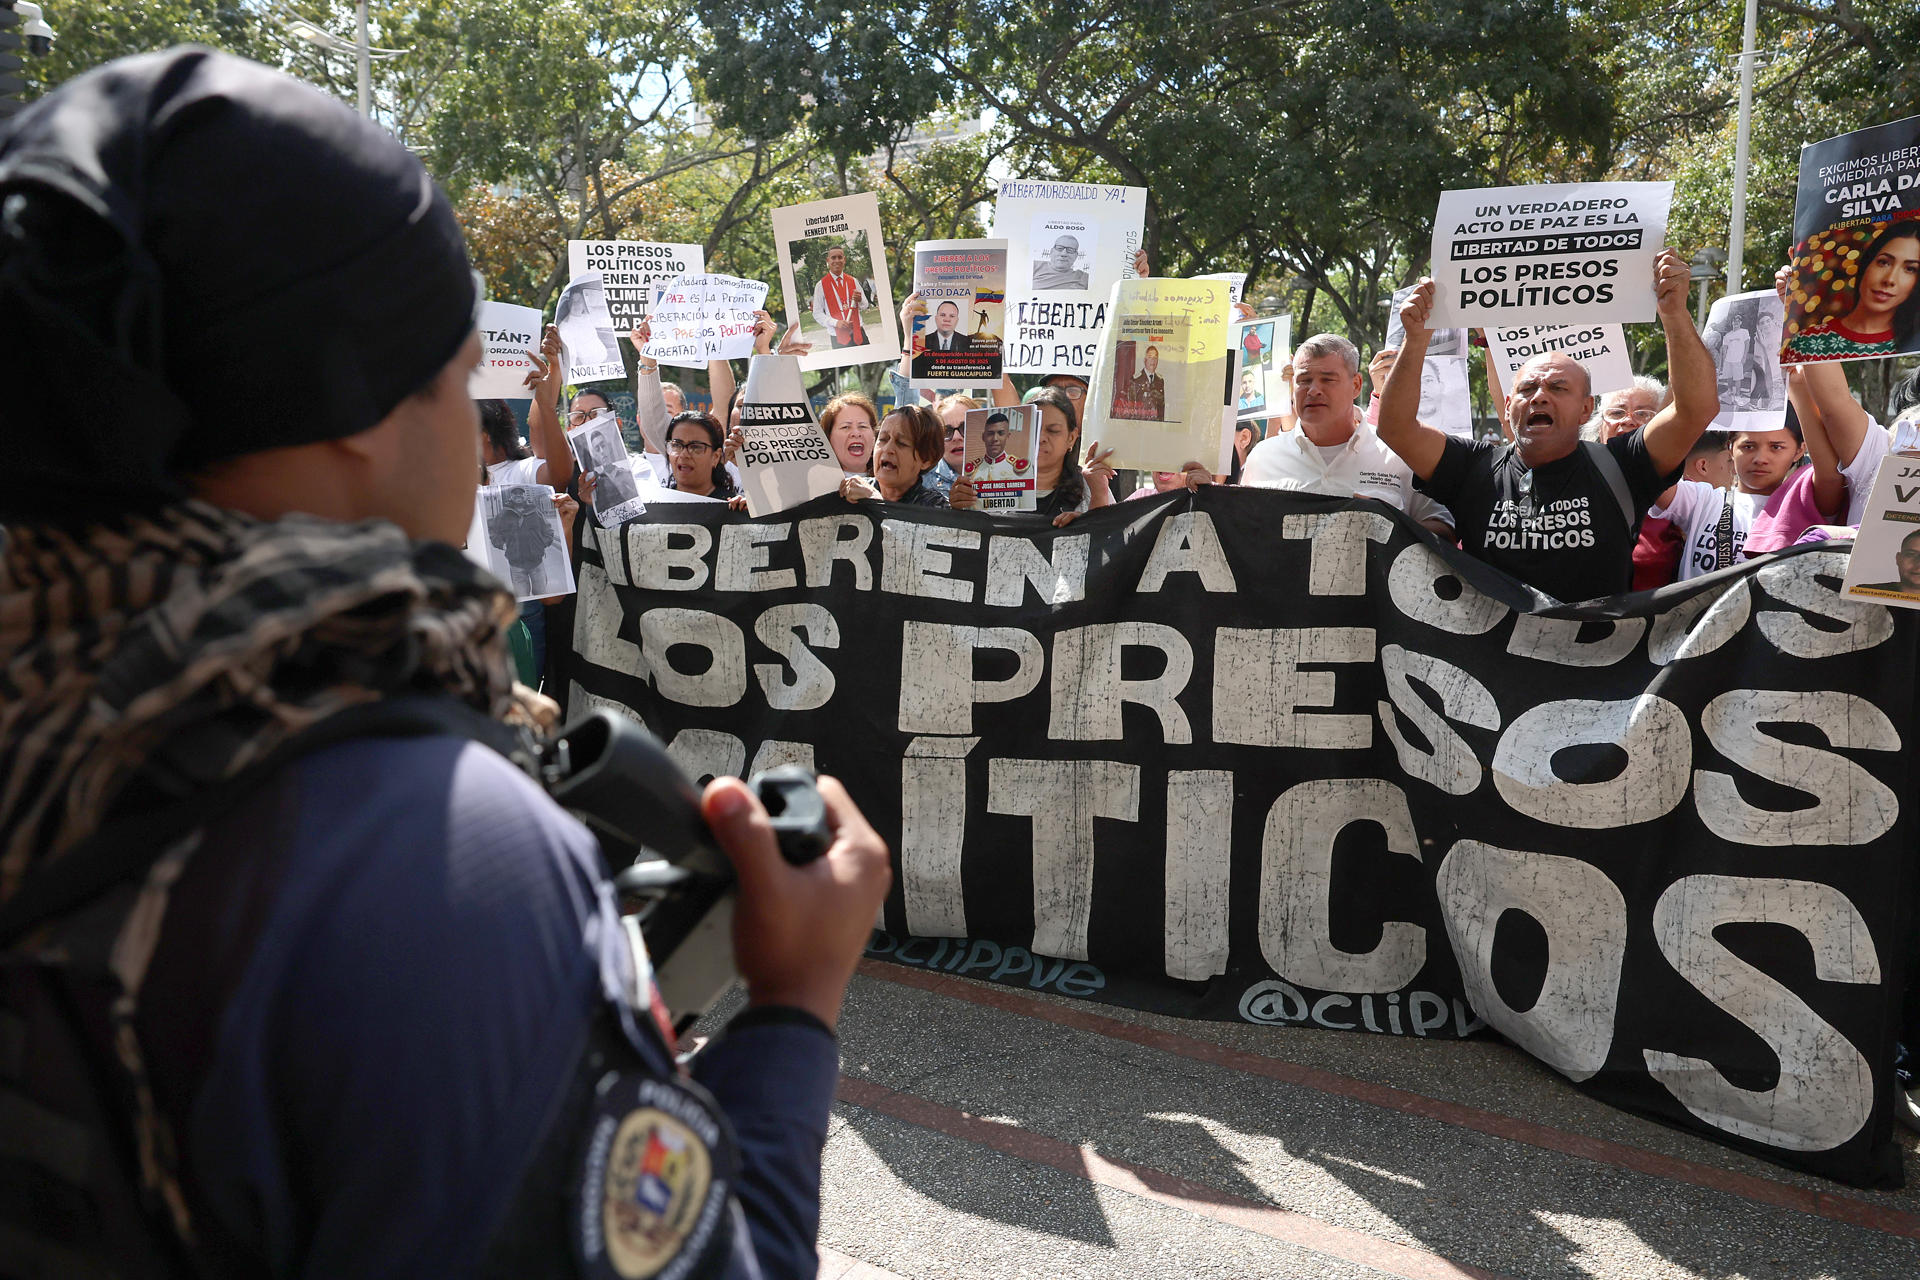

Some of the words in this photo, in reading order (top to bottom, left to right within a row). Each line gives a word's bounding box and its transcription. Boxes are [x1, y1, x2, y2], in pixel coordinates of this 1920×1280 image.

[1819, 155, 1878, 178] EXIGIMOS
[1823, 163, 1894, 187] INMEDIATA
[1105, 187, 1126, 203] YA!
[1825, 178, 1892, 204] CARLA
[1475, 205, 1502, 218] UN
[1507, 198, 1629, 216] VERDADERO
[1842, 194, 1902, 218] SILVA
[804, 227, 828, 238] KENNEDY
[828, 223, 849, 234] TEJEDA
[805, 214, 830, 226] Libertad
[830, 213, 844, 223] para
[1454, 220, 1504, 235] ACTO
[1509, 218, 1535, 231] DE
[1541, 216, 1579, 229] PAZ
[1584, 214, 1608, 226] ES
[1613, 212, 1639, 225] LA
[586, 245, 614, 256] LOS
[618, 245, 673, 258] PRESOS
[1453, 239, 1539, 257] LIBERTAD
[1543, 238, 1569, 251] DE
[1573, 233, 1640, 249] TODOS
[587, 257, 663, 271] POLÍTICOS
[666, 260, 686, 272] NO
[1460, 265, 1507, 285] LOS
[1515, 259, 1619, 282] PRESOS
[602, 273, 639, 285] ENEN
[919, 289, 943, 297] USTO
[946, 288, 971, 297] DAZA
[1460, 282, 1614, 309] POLÍTICOS
[1017, 297, 1109, 329] LIBERTA
[1020, 328, 1054, 340] PARA
[1497, 327, 1530, 342] LOS
[1506, 326, 1605, 358] POLÍTICOS
[1052, 343, 1096, 368] ROS
[770, 425, 818, 438] TODOS
[742, 440, 768, 453] LOS
[769, 437, 824, 450] PRESOS
[745, 448, 830, 468] POLÍTICOS
[983, 498, 1015, 508] LIBERTAD
[1549, 497, 1589, 513] TODOS
[1488, 512, 1518, 529] LOS
[1521, 510, 1591, 532] PRESOS
[1719, 505, 1732, 531] GUESS
[1484, 528, 1595, 550] POLÍTICOS
[1136, 511, 1237, 593] A
[572, 561, 840, 711] LOS
[898, 620, 1902, 847] PRESOS
